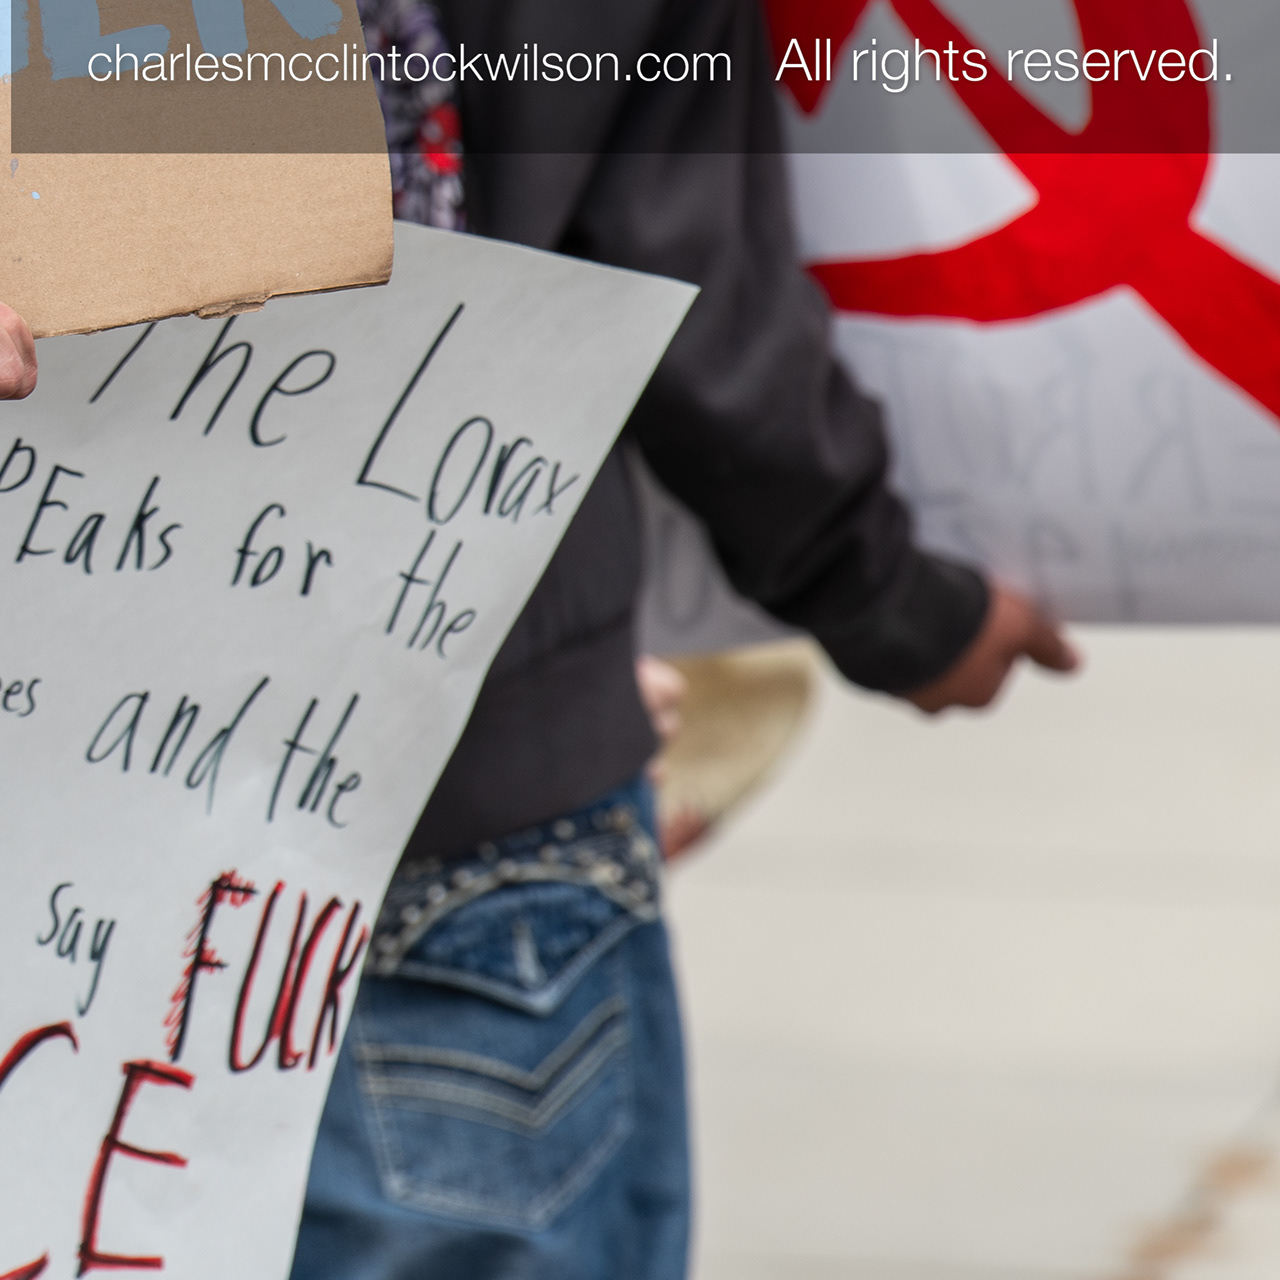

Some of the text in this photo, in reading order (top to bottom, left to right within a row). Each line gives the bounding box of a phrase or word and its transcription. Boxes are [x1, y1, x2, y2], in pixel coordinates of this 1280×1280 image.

[356, 302, 580, 524] Lorax
[232, 503, 332, 597] for
[385, 530, 476, 659] the
[86, 676, 270, 815] and
[267, 693, 361, 828] the
[36, 882, 117, 1017] say
[163, 869, 370, 1073] FUCK
